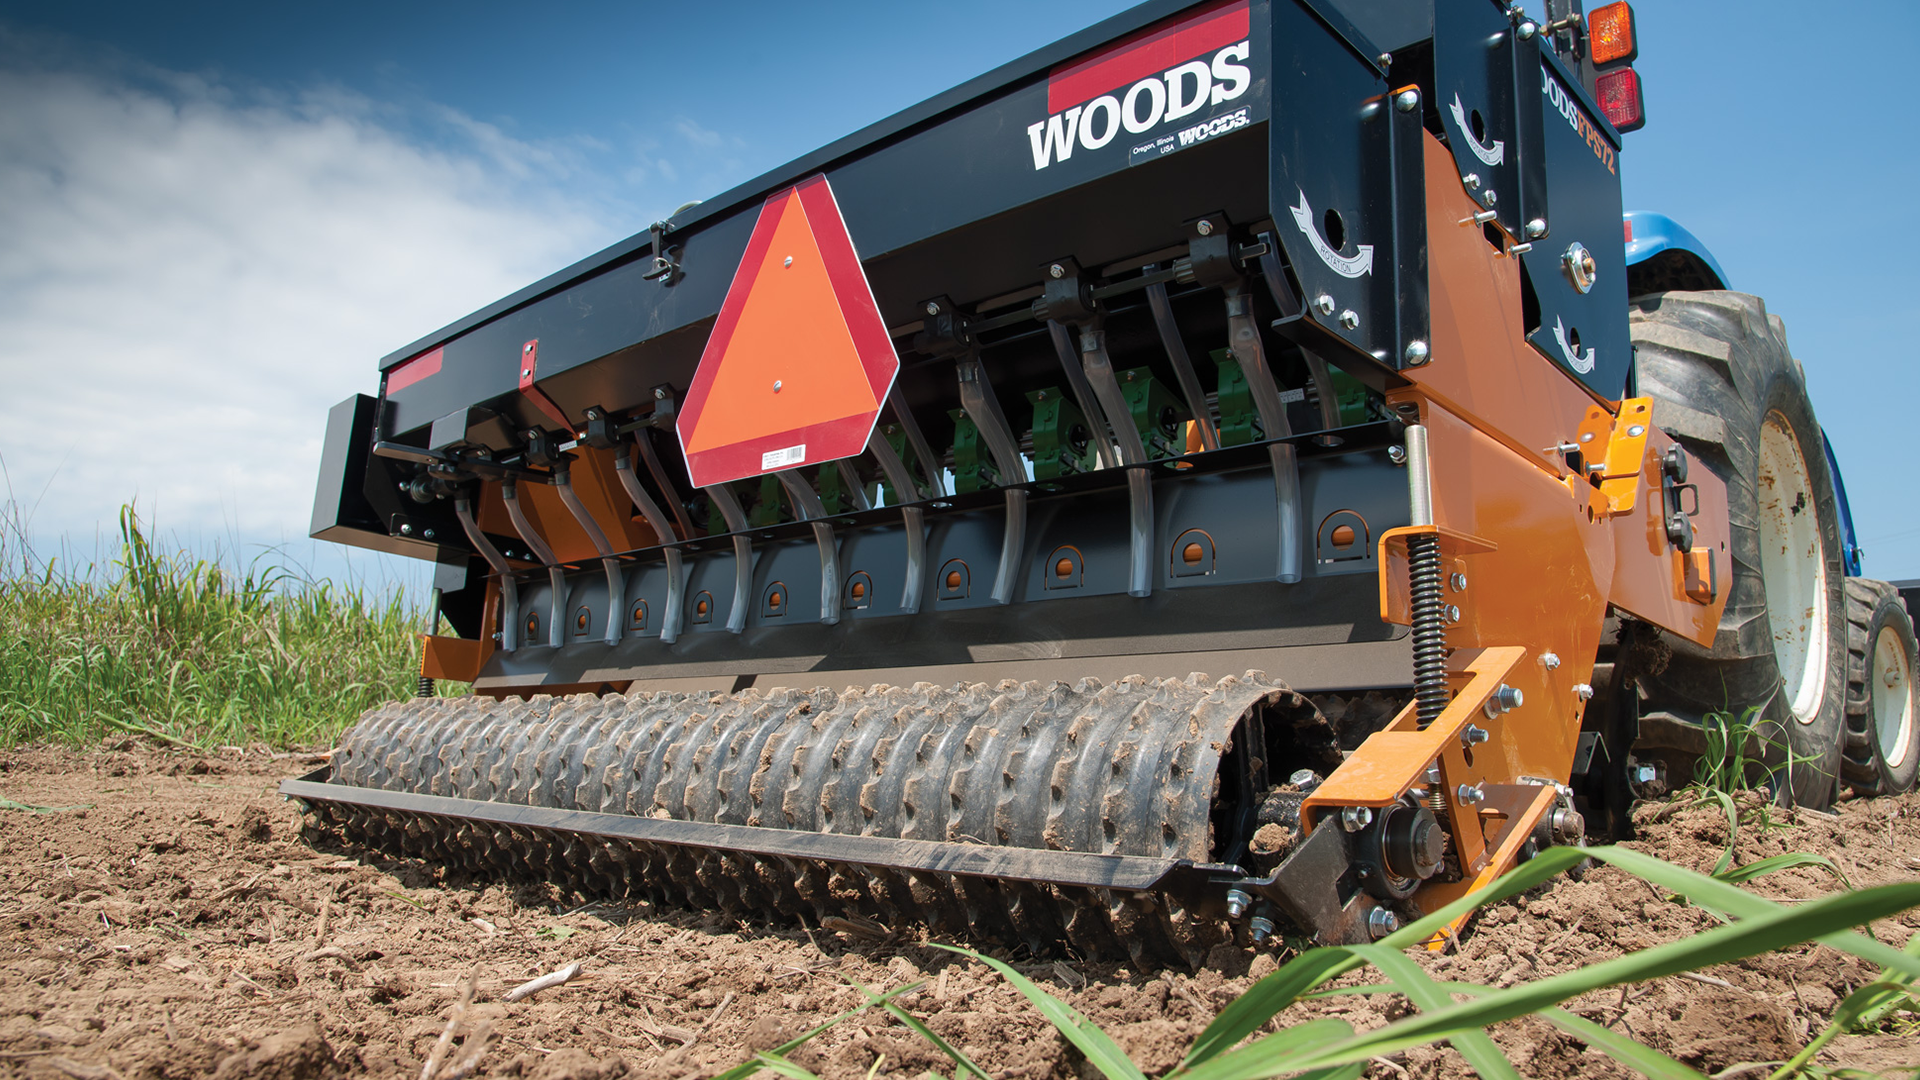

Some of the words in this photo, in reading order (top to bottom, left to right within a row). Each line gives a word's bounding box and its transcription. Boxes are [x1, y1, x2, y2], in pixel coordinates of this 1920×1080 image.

[1027, 40, 1251, 171] WOODS
[1132, 143, 1156, 155] Oregon,
[1156, 135, 1175, 146] Illinois
[1160, 144, 1175, 154] USA
[1321, 245, 1351, 272] ROTATION
